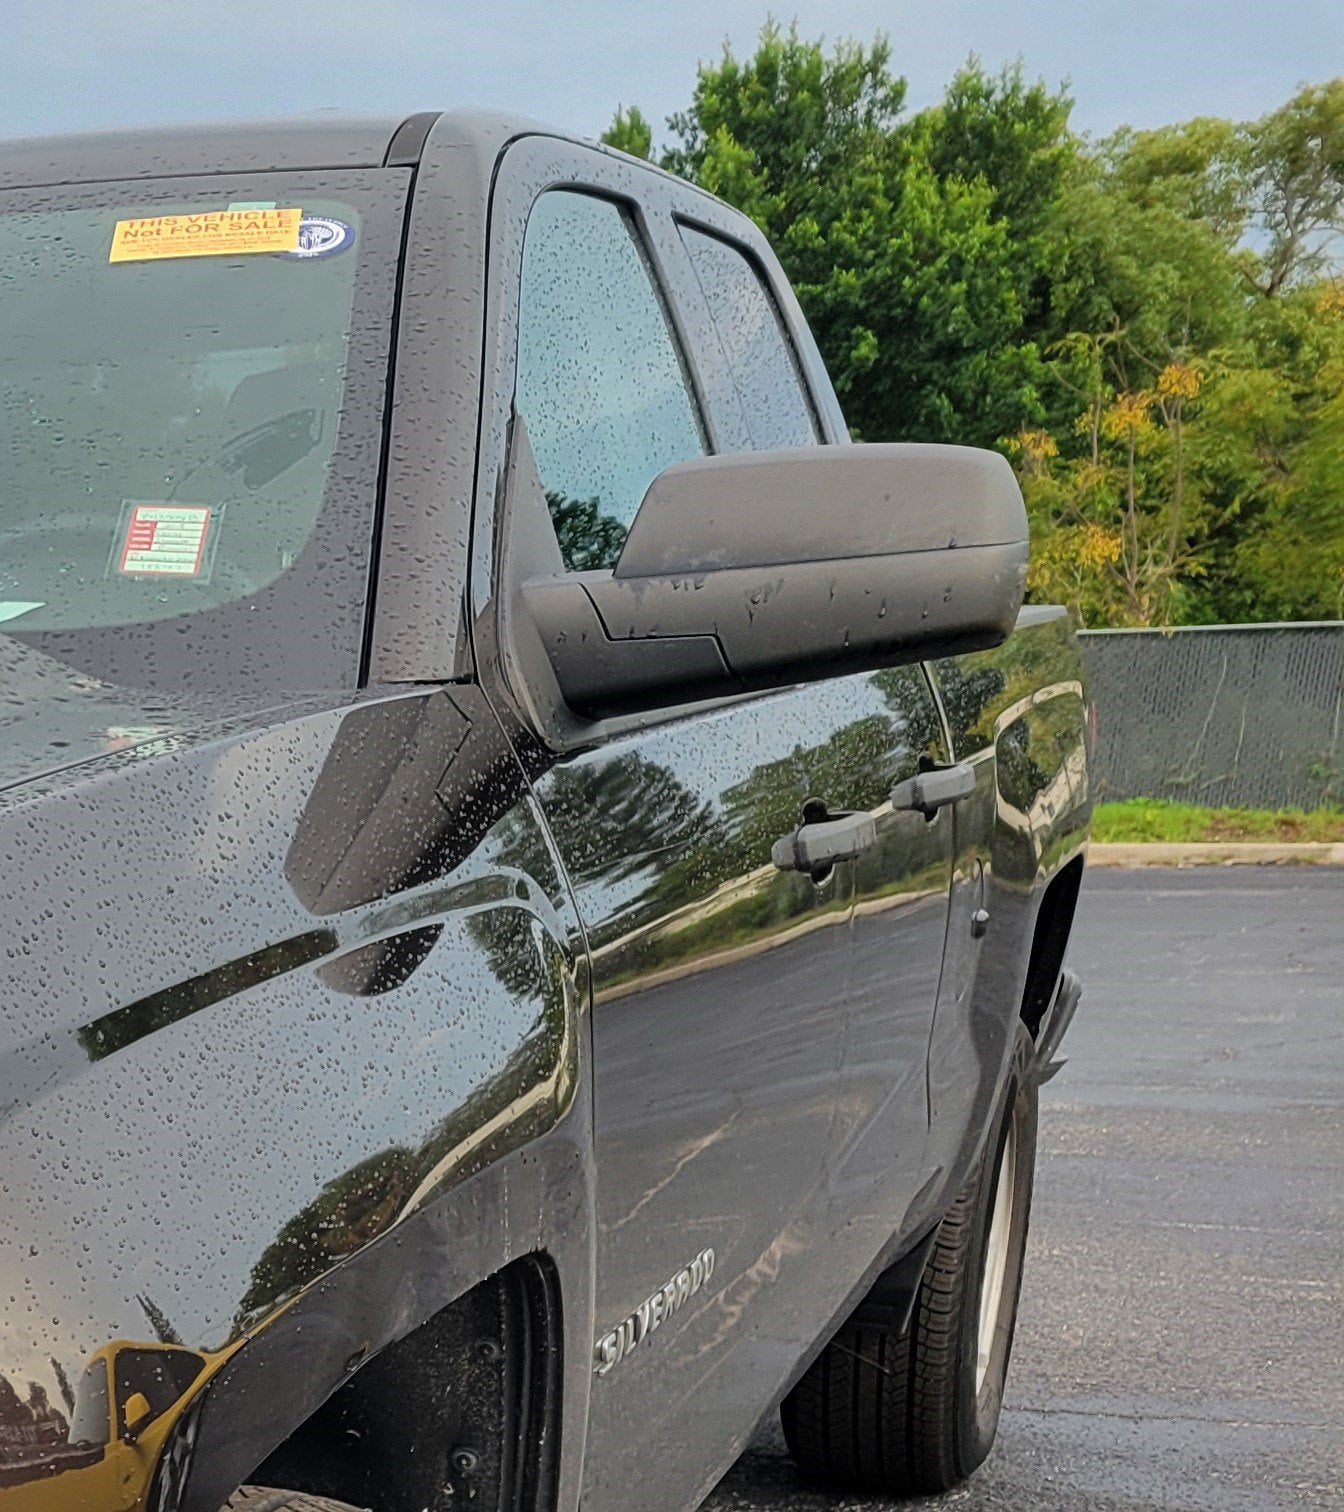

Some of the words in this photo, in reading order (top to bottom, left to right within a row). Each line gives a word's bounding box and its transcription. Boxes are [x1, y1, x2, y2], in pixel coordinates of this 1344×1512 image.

[123, 228, 162, 239] Not
[170, 223, 220, 235] FOR
[228, 218, 293, 231] SALE
[128, 217, 178, 229] THIS
[187, 211, 291, 223] VEHICLE
[593, 1247, 715, 1377] SILVERADO
